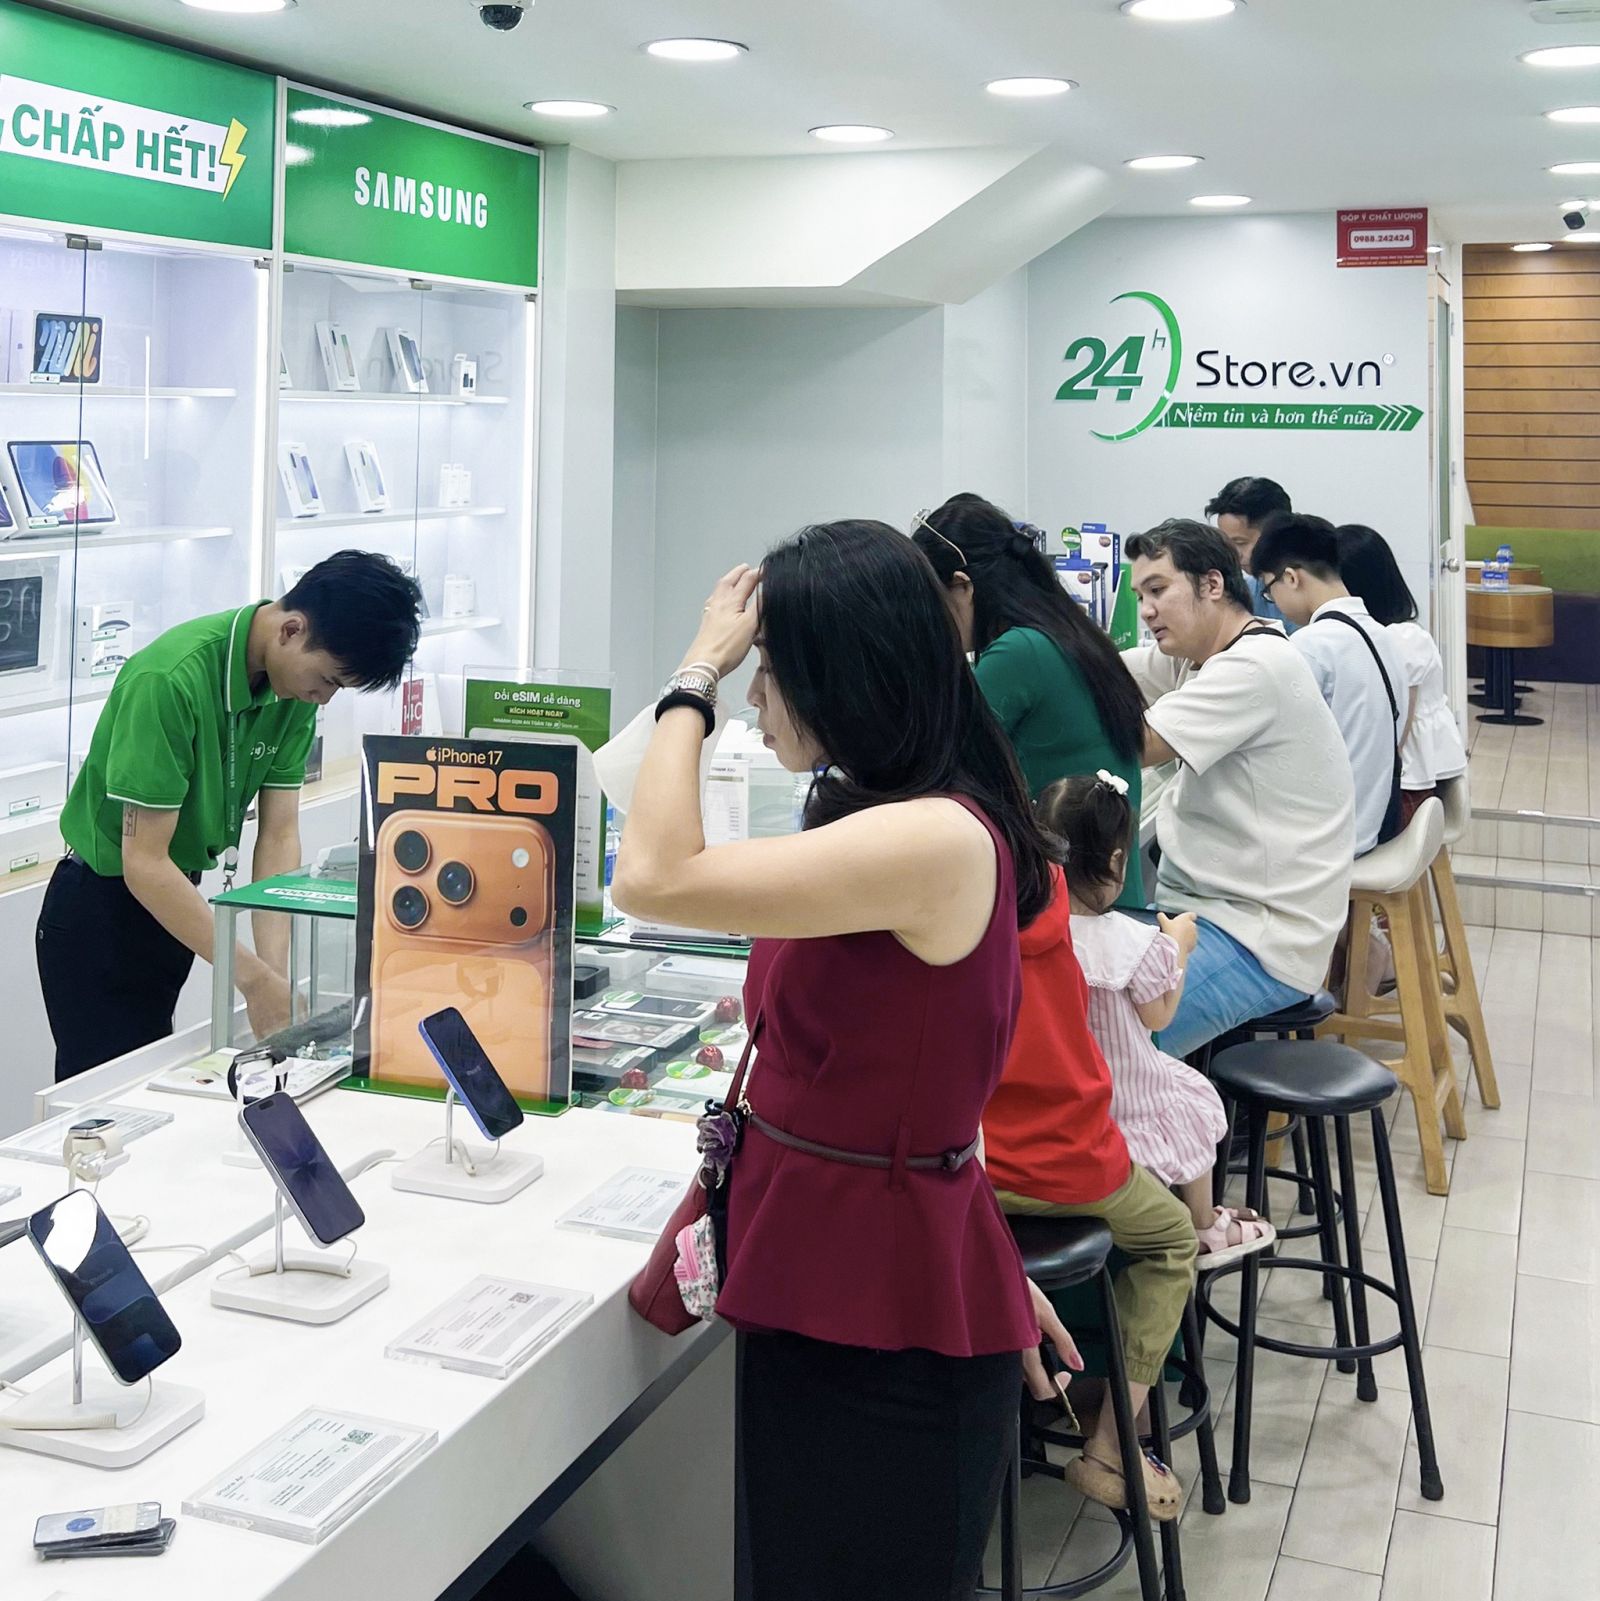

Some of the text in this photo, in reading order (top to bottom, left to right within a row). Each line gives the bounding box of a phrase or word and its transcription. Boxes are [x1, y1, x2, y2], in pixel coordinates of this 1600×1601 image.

[12, 104, 217, 182] CHẤP HẾT!
[354, 166, 488, 229] SAMSUNG
[1368, 211, 1392, 221] CHẤT
[1353, 234, 1410, 243] 0988.242424
[1196, 350, 1381, 387] Store.vn
[1173, 404, 1374, 425] Niềm tin và hơn thế nữa
[512, 691, 541, 703] eSIM
[557, 695, 581, 708] dàng
[509, 706, 564, 718] KÍCH HOẠT NGAY
[438, 748, 503, 766] iPhone 17
[377, 761, 559, 815] PRO
